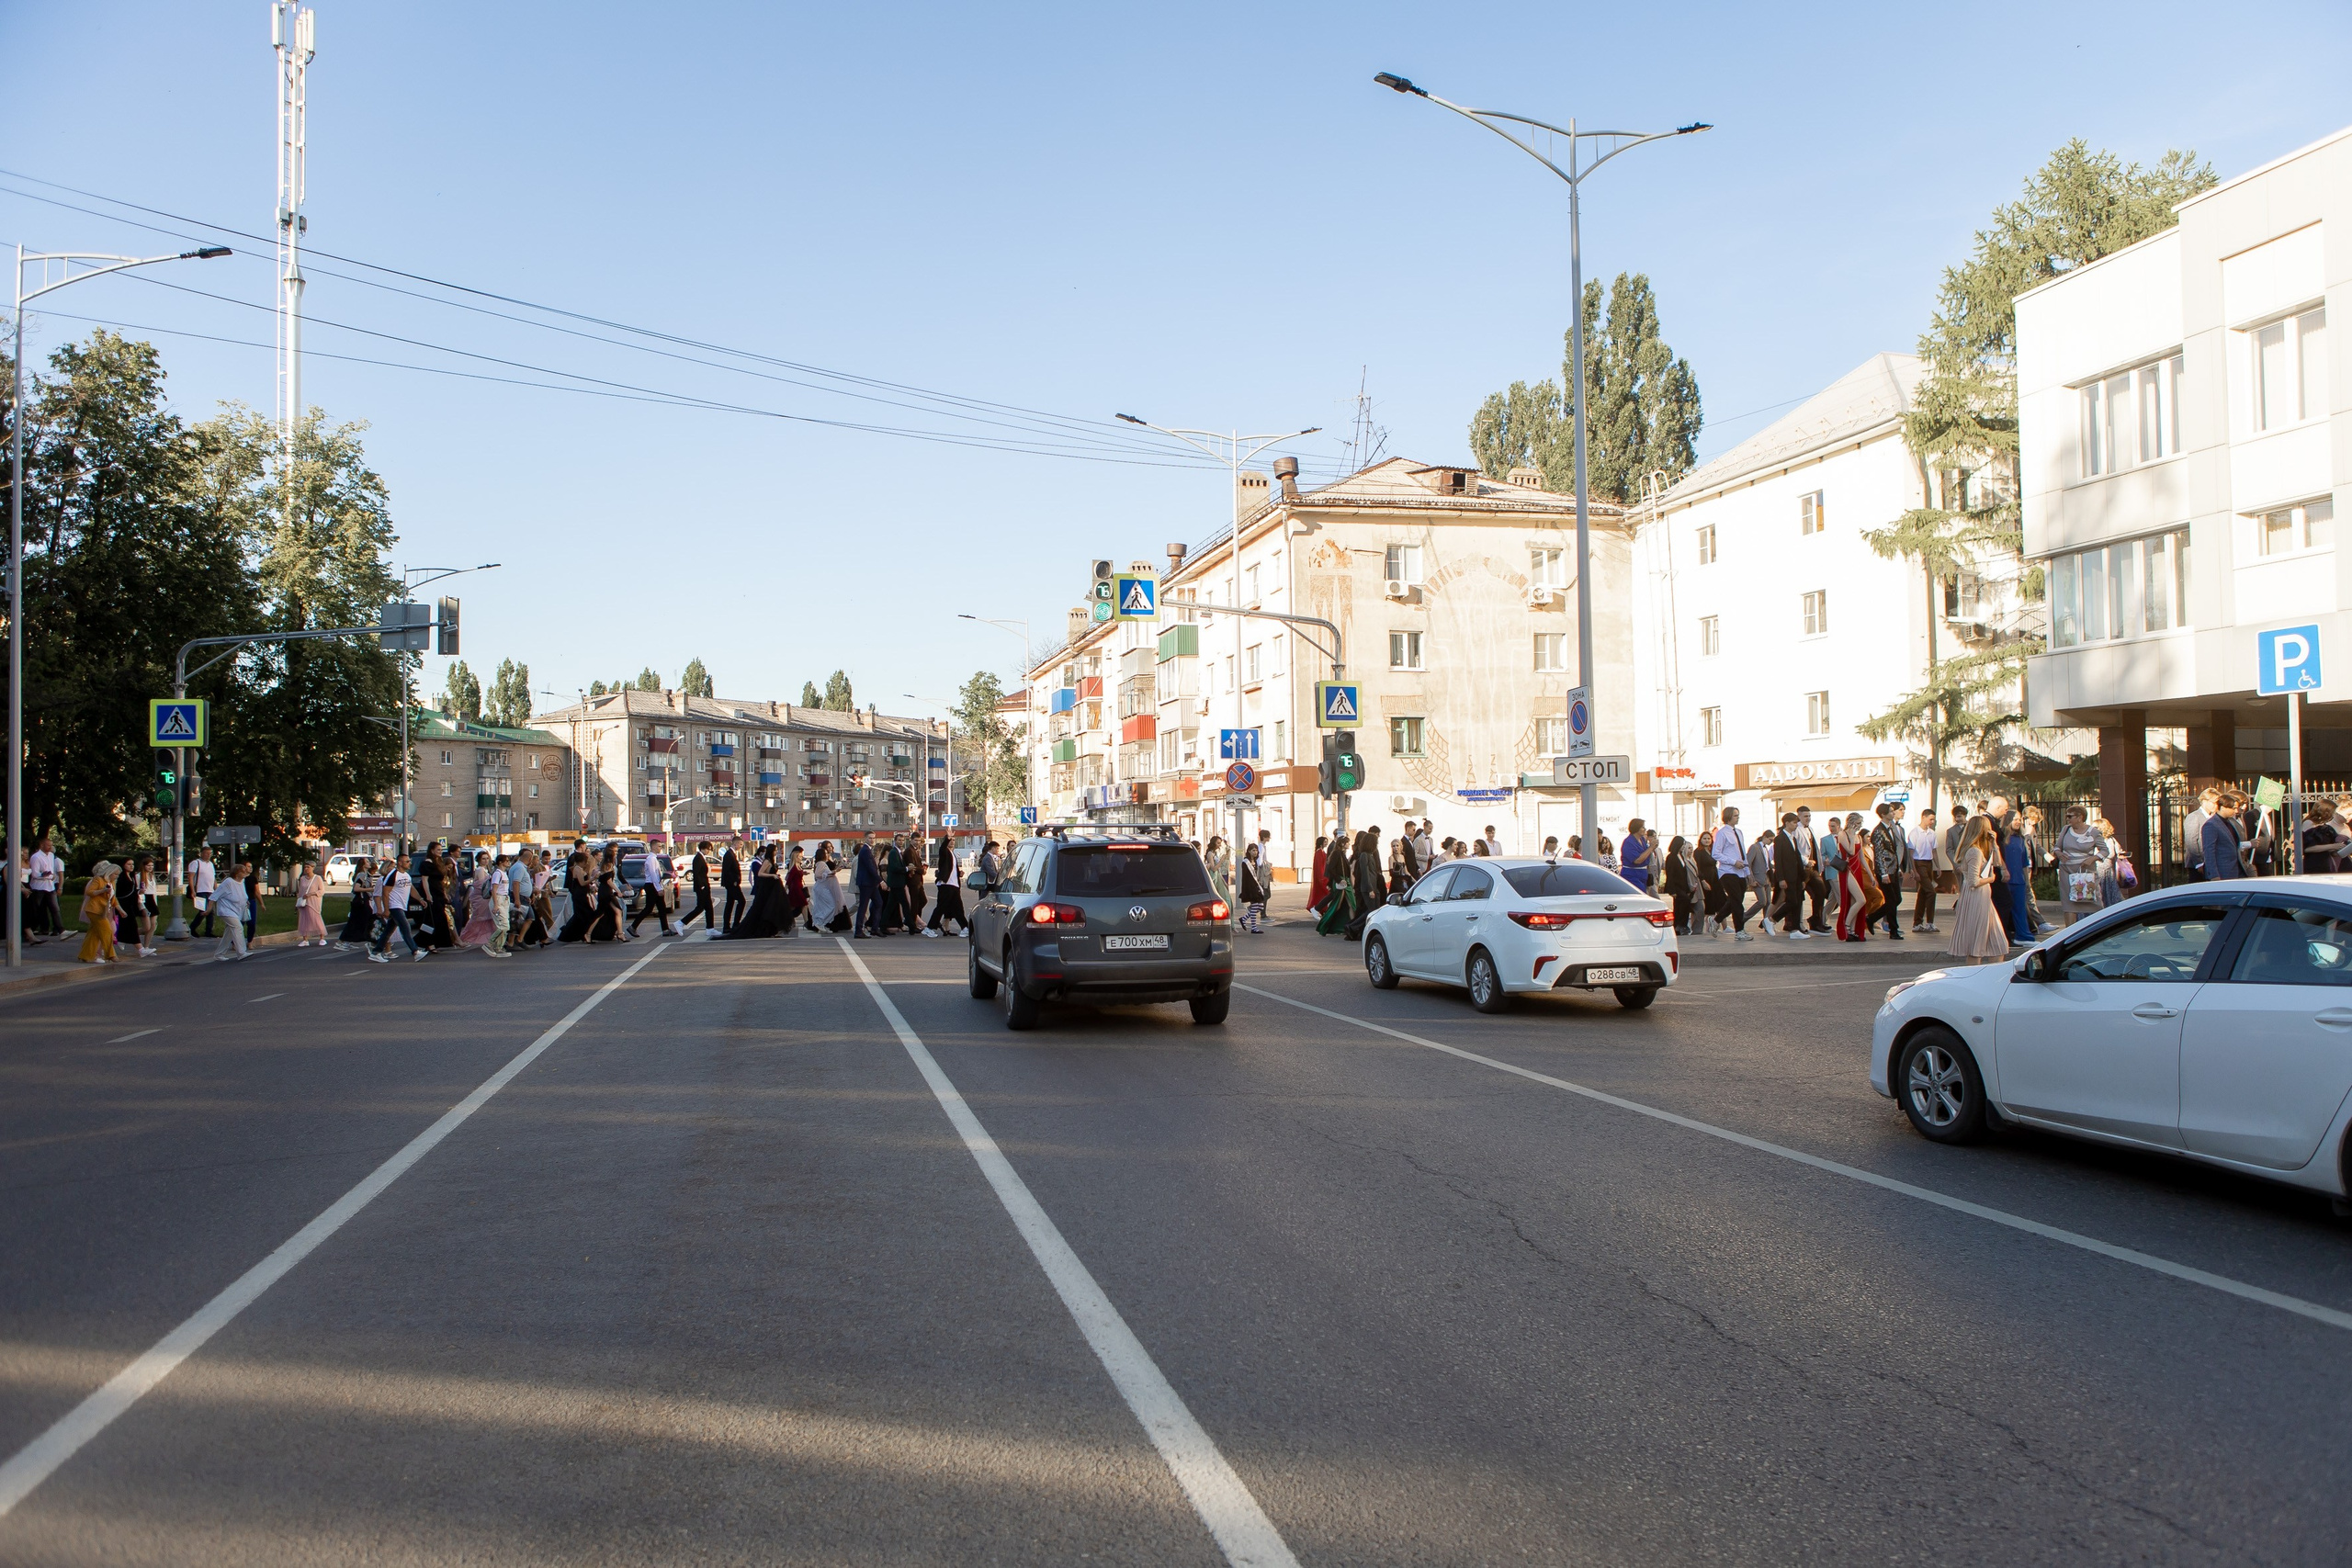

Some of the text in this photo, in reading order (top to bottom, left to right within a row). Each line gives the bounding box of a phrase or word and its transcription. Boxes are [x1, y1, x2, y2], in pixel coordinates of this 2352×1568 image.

[2274, 633, 2310, 687] P
[1571, 690, 1585, 701] ЗОНА
[1340, 755, 1353, 767] 76
[1566, 761, 1619, 779] СТОП
[1754, 761, 1885, 784] АДВОКАТЫ
[161, 772, 175, 784] 76
[990, 817, 1019, 826] ДРОВА
